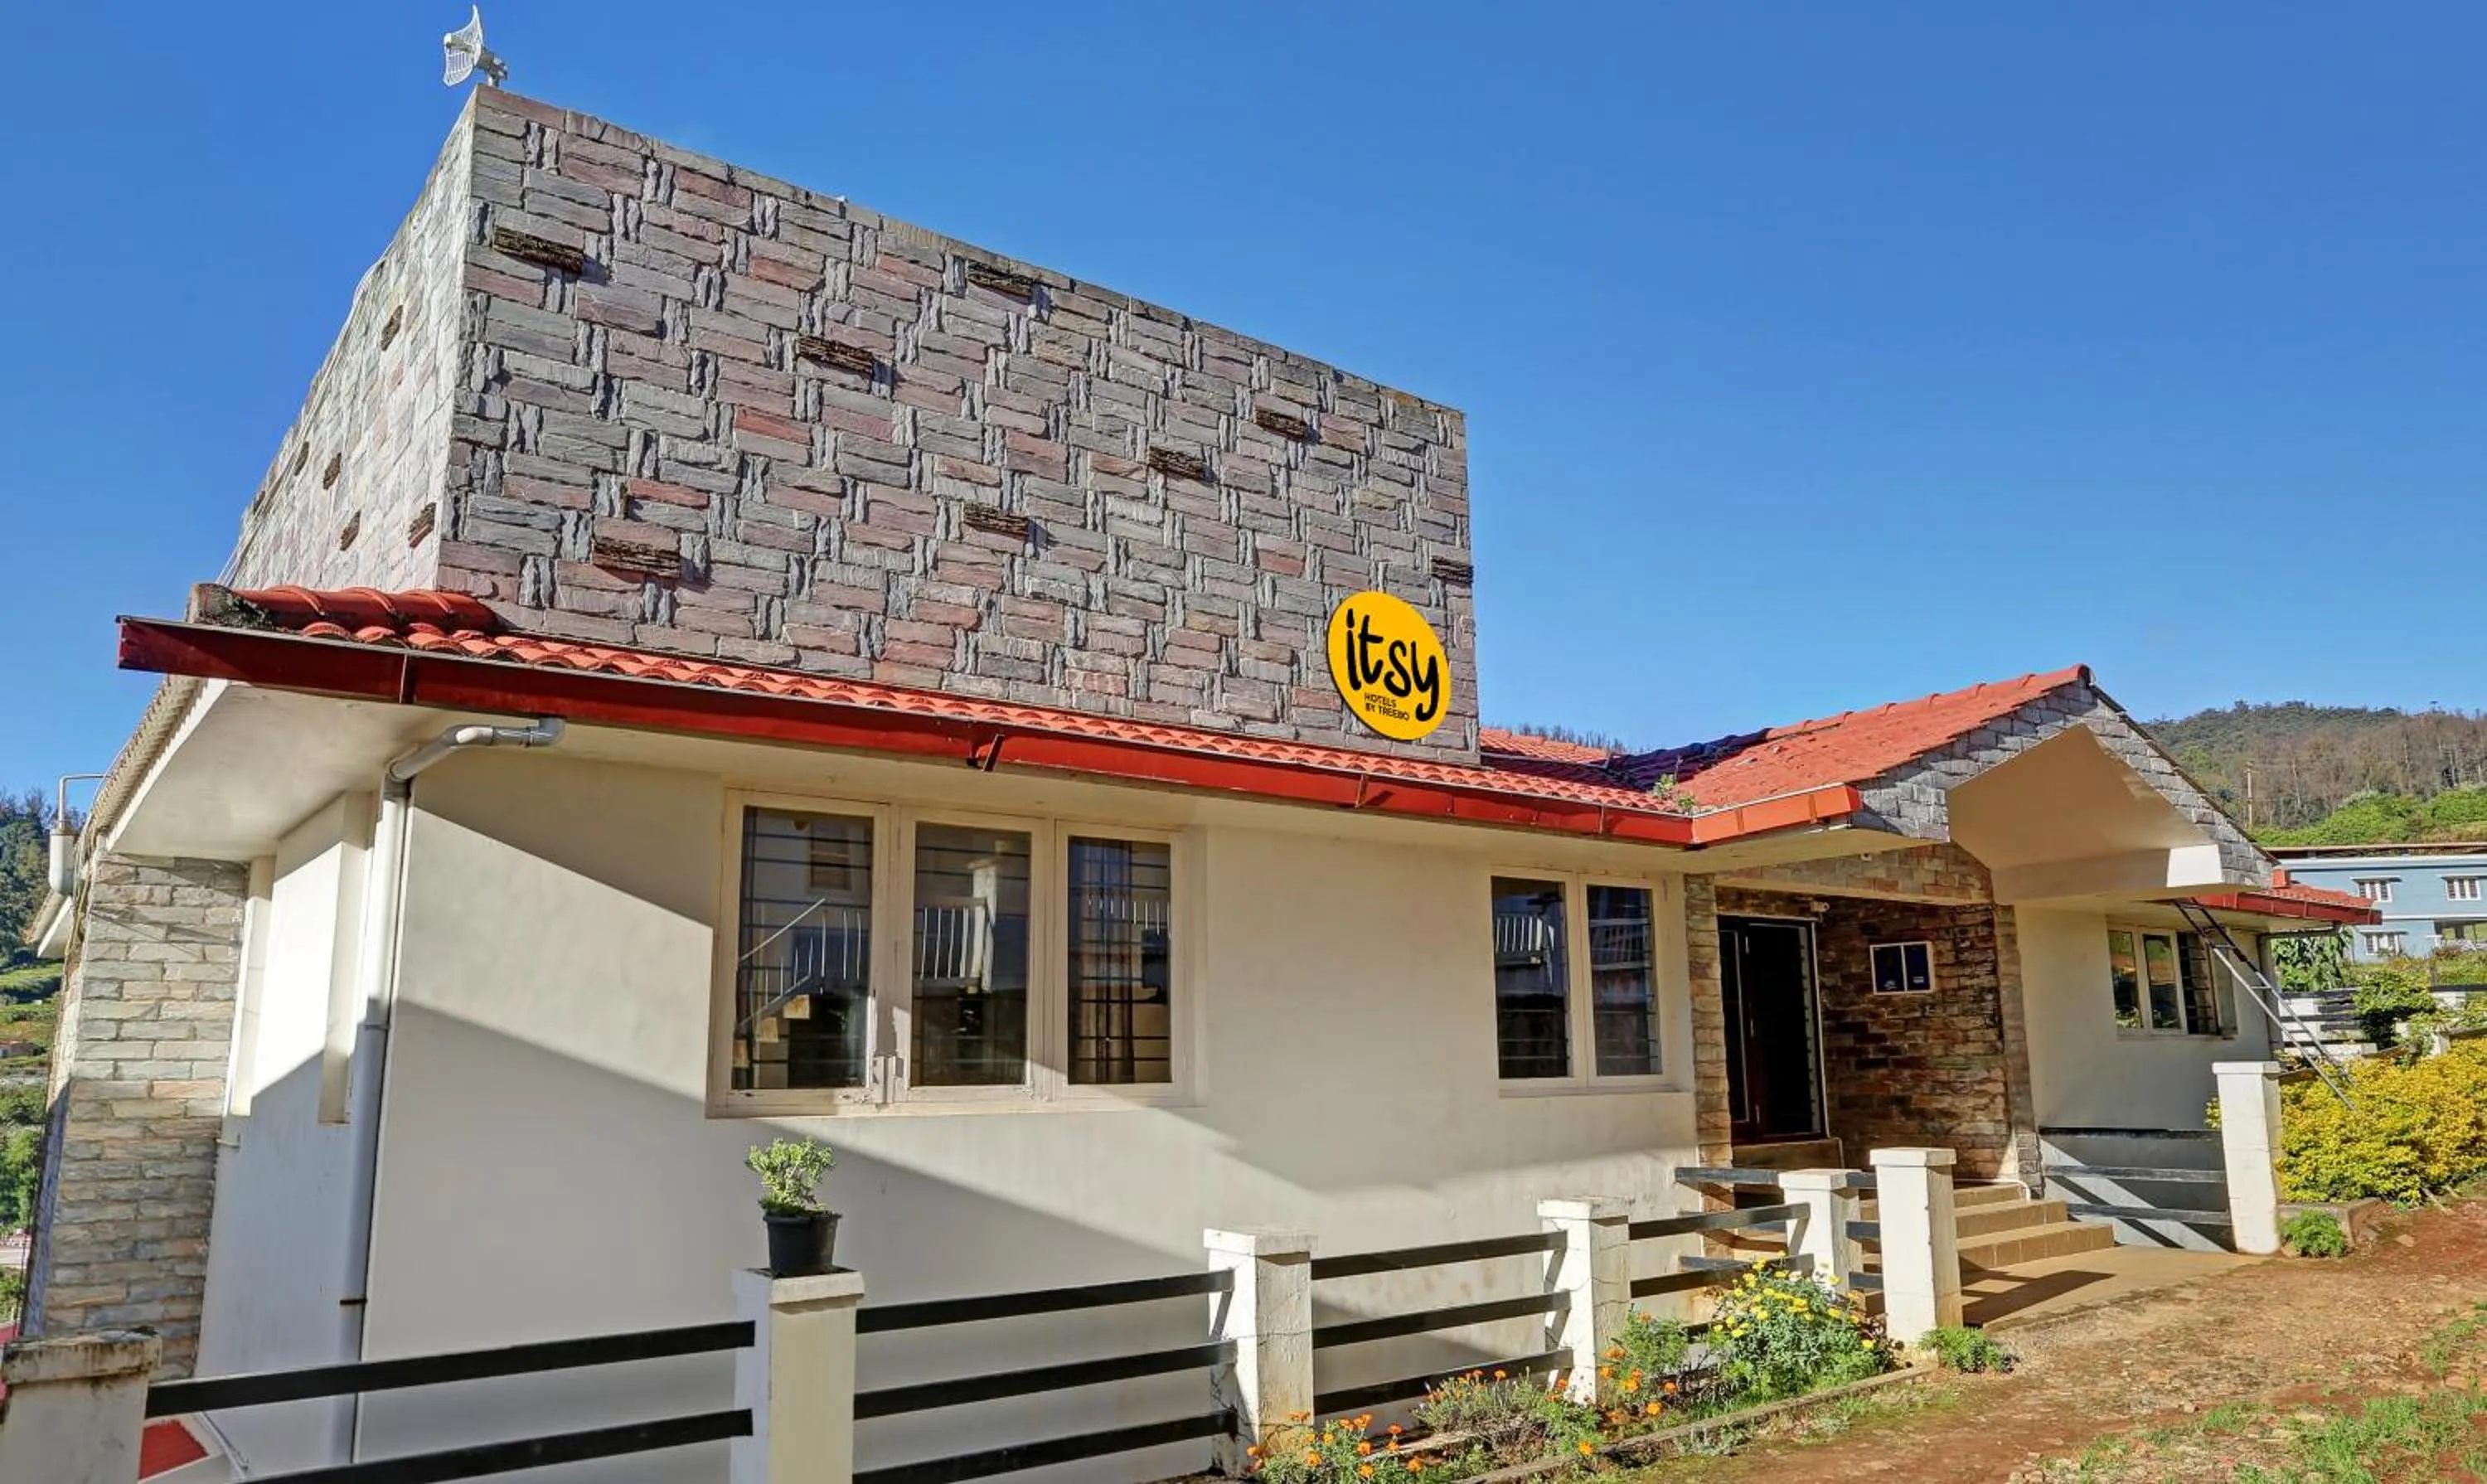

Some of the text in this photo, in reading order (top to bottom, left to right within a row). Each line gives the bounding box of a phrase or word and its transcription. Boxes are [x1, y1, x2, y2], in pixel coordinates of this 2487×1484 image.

[1346, 608, 1439, 721] itsy
[1364, 692, 1396, 707] HOTELS
[1365, 702, 1409, 720] BY TREEBO
